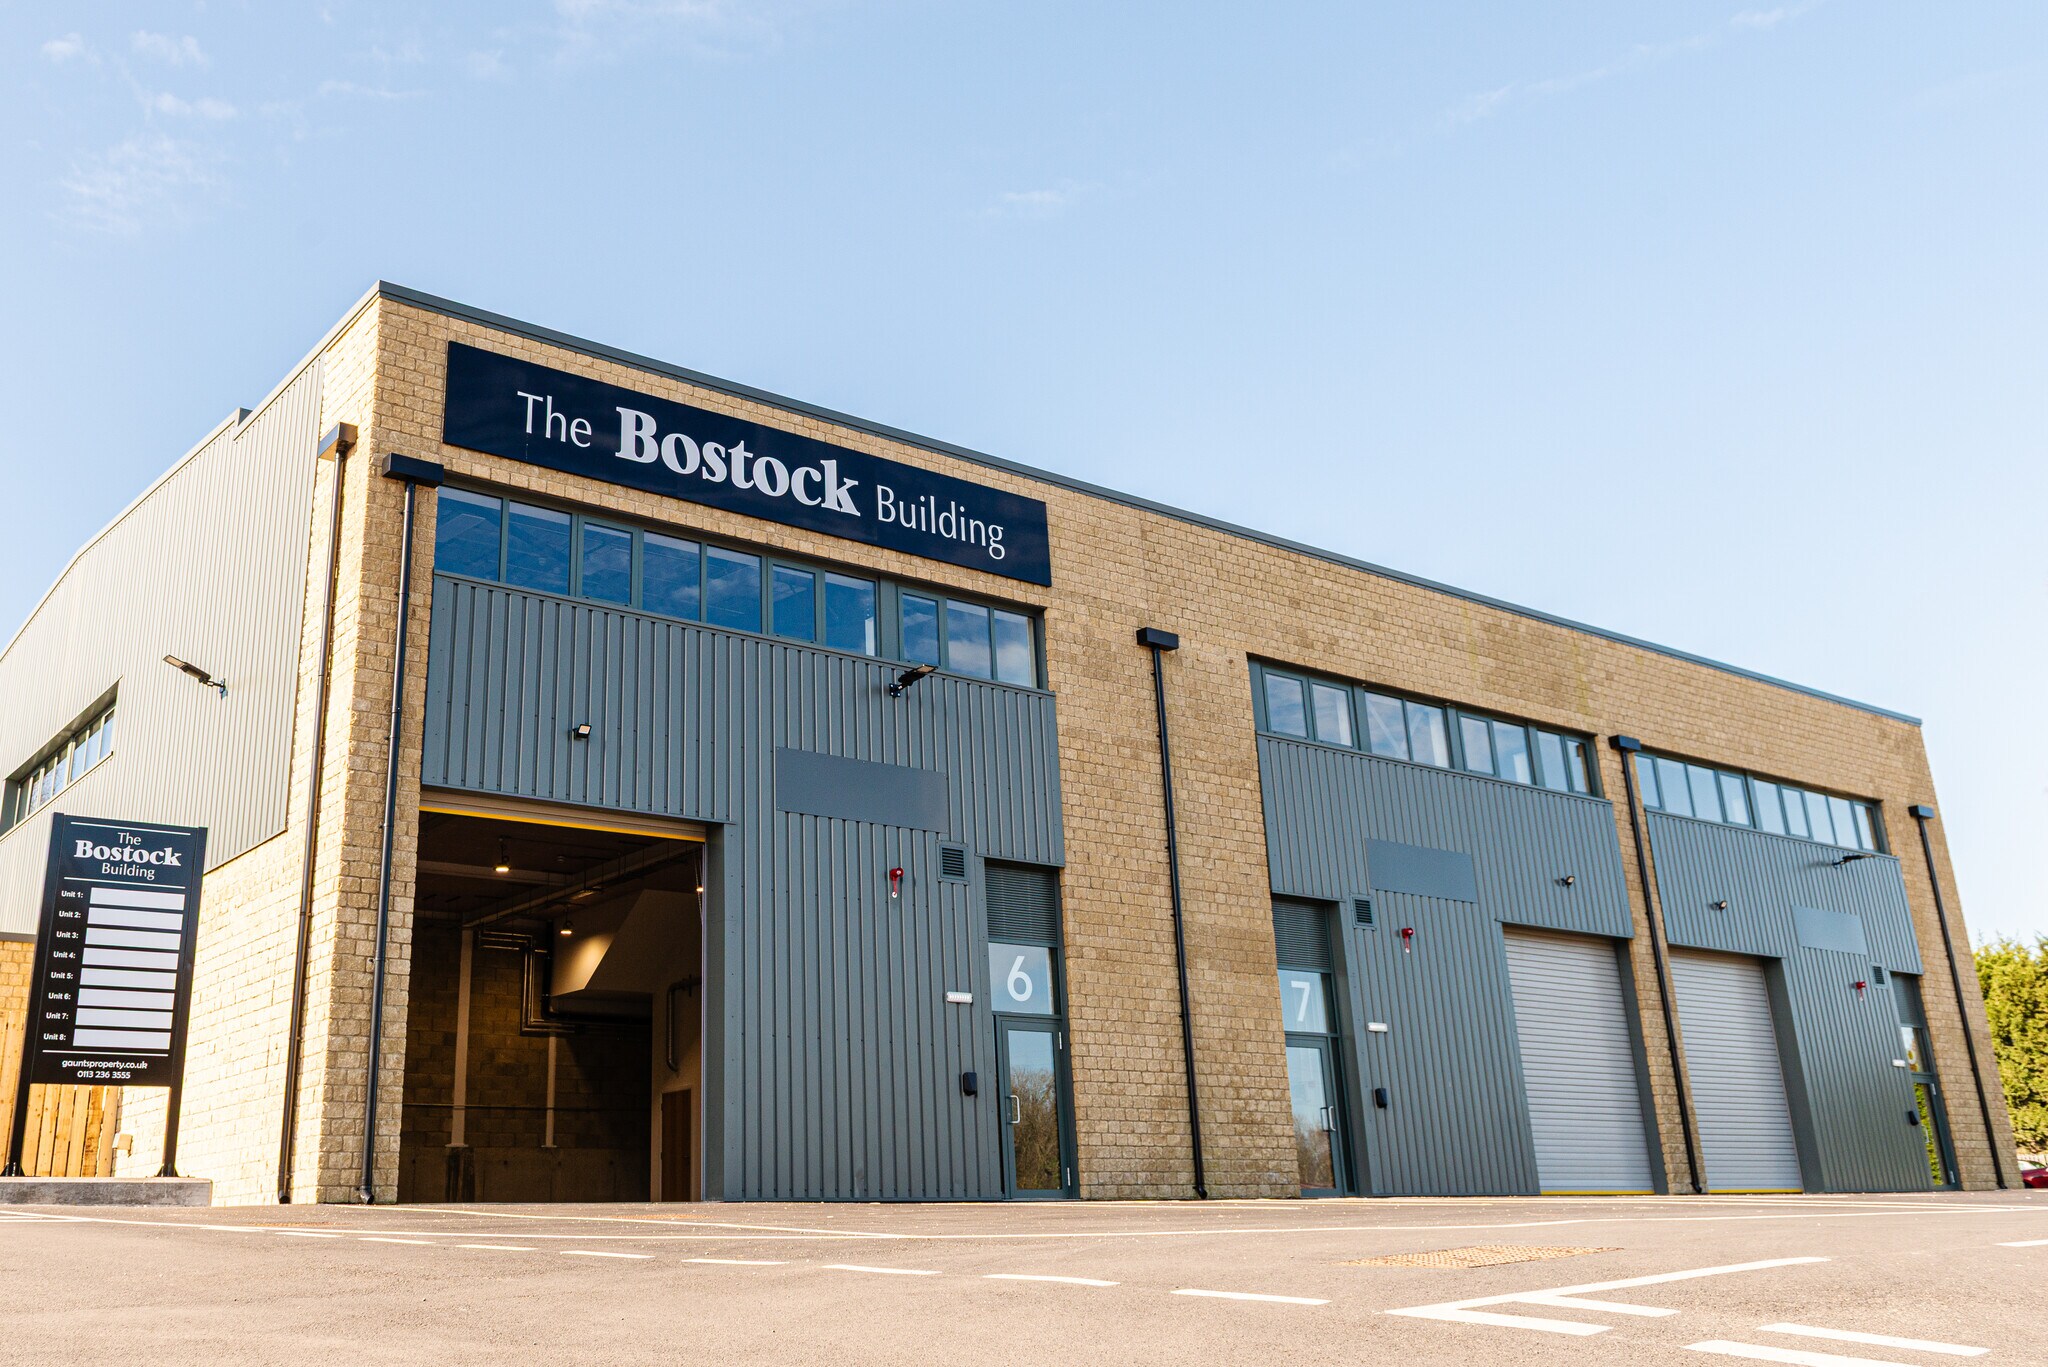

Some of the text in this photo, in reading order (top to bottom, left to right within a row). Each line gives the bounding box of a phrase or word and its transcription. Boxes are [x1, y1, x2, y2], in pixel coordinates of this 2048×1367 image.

[516, 391, 1006, 561] The Bostock Building
[117, 832, 142, 846] The
[73, 839, 182, 867] Bostock
[101, 862, 155, 881] Building
[61, 890, 76, 898] Unit
[58, 910, 81, 919] Unit 2:
[56, 930, 79, 939] Unit 3:
[53, 950, 68, 959] Unit
[50, 971, 74, 980] Unit 5:
[1006, 955, 1033, 1002] 6
[48, 992, 63, 1000] Unit
[1290, 980, 1311, 1022] 7
[45, 1012, 61, 1020] Unit
[43, 1033, 59, 1041] Unit
[61, 1059, 148, 1070] gauntsproperty.co.uk
[76, 1070, 131, 1079] 0113 236 3555
